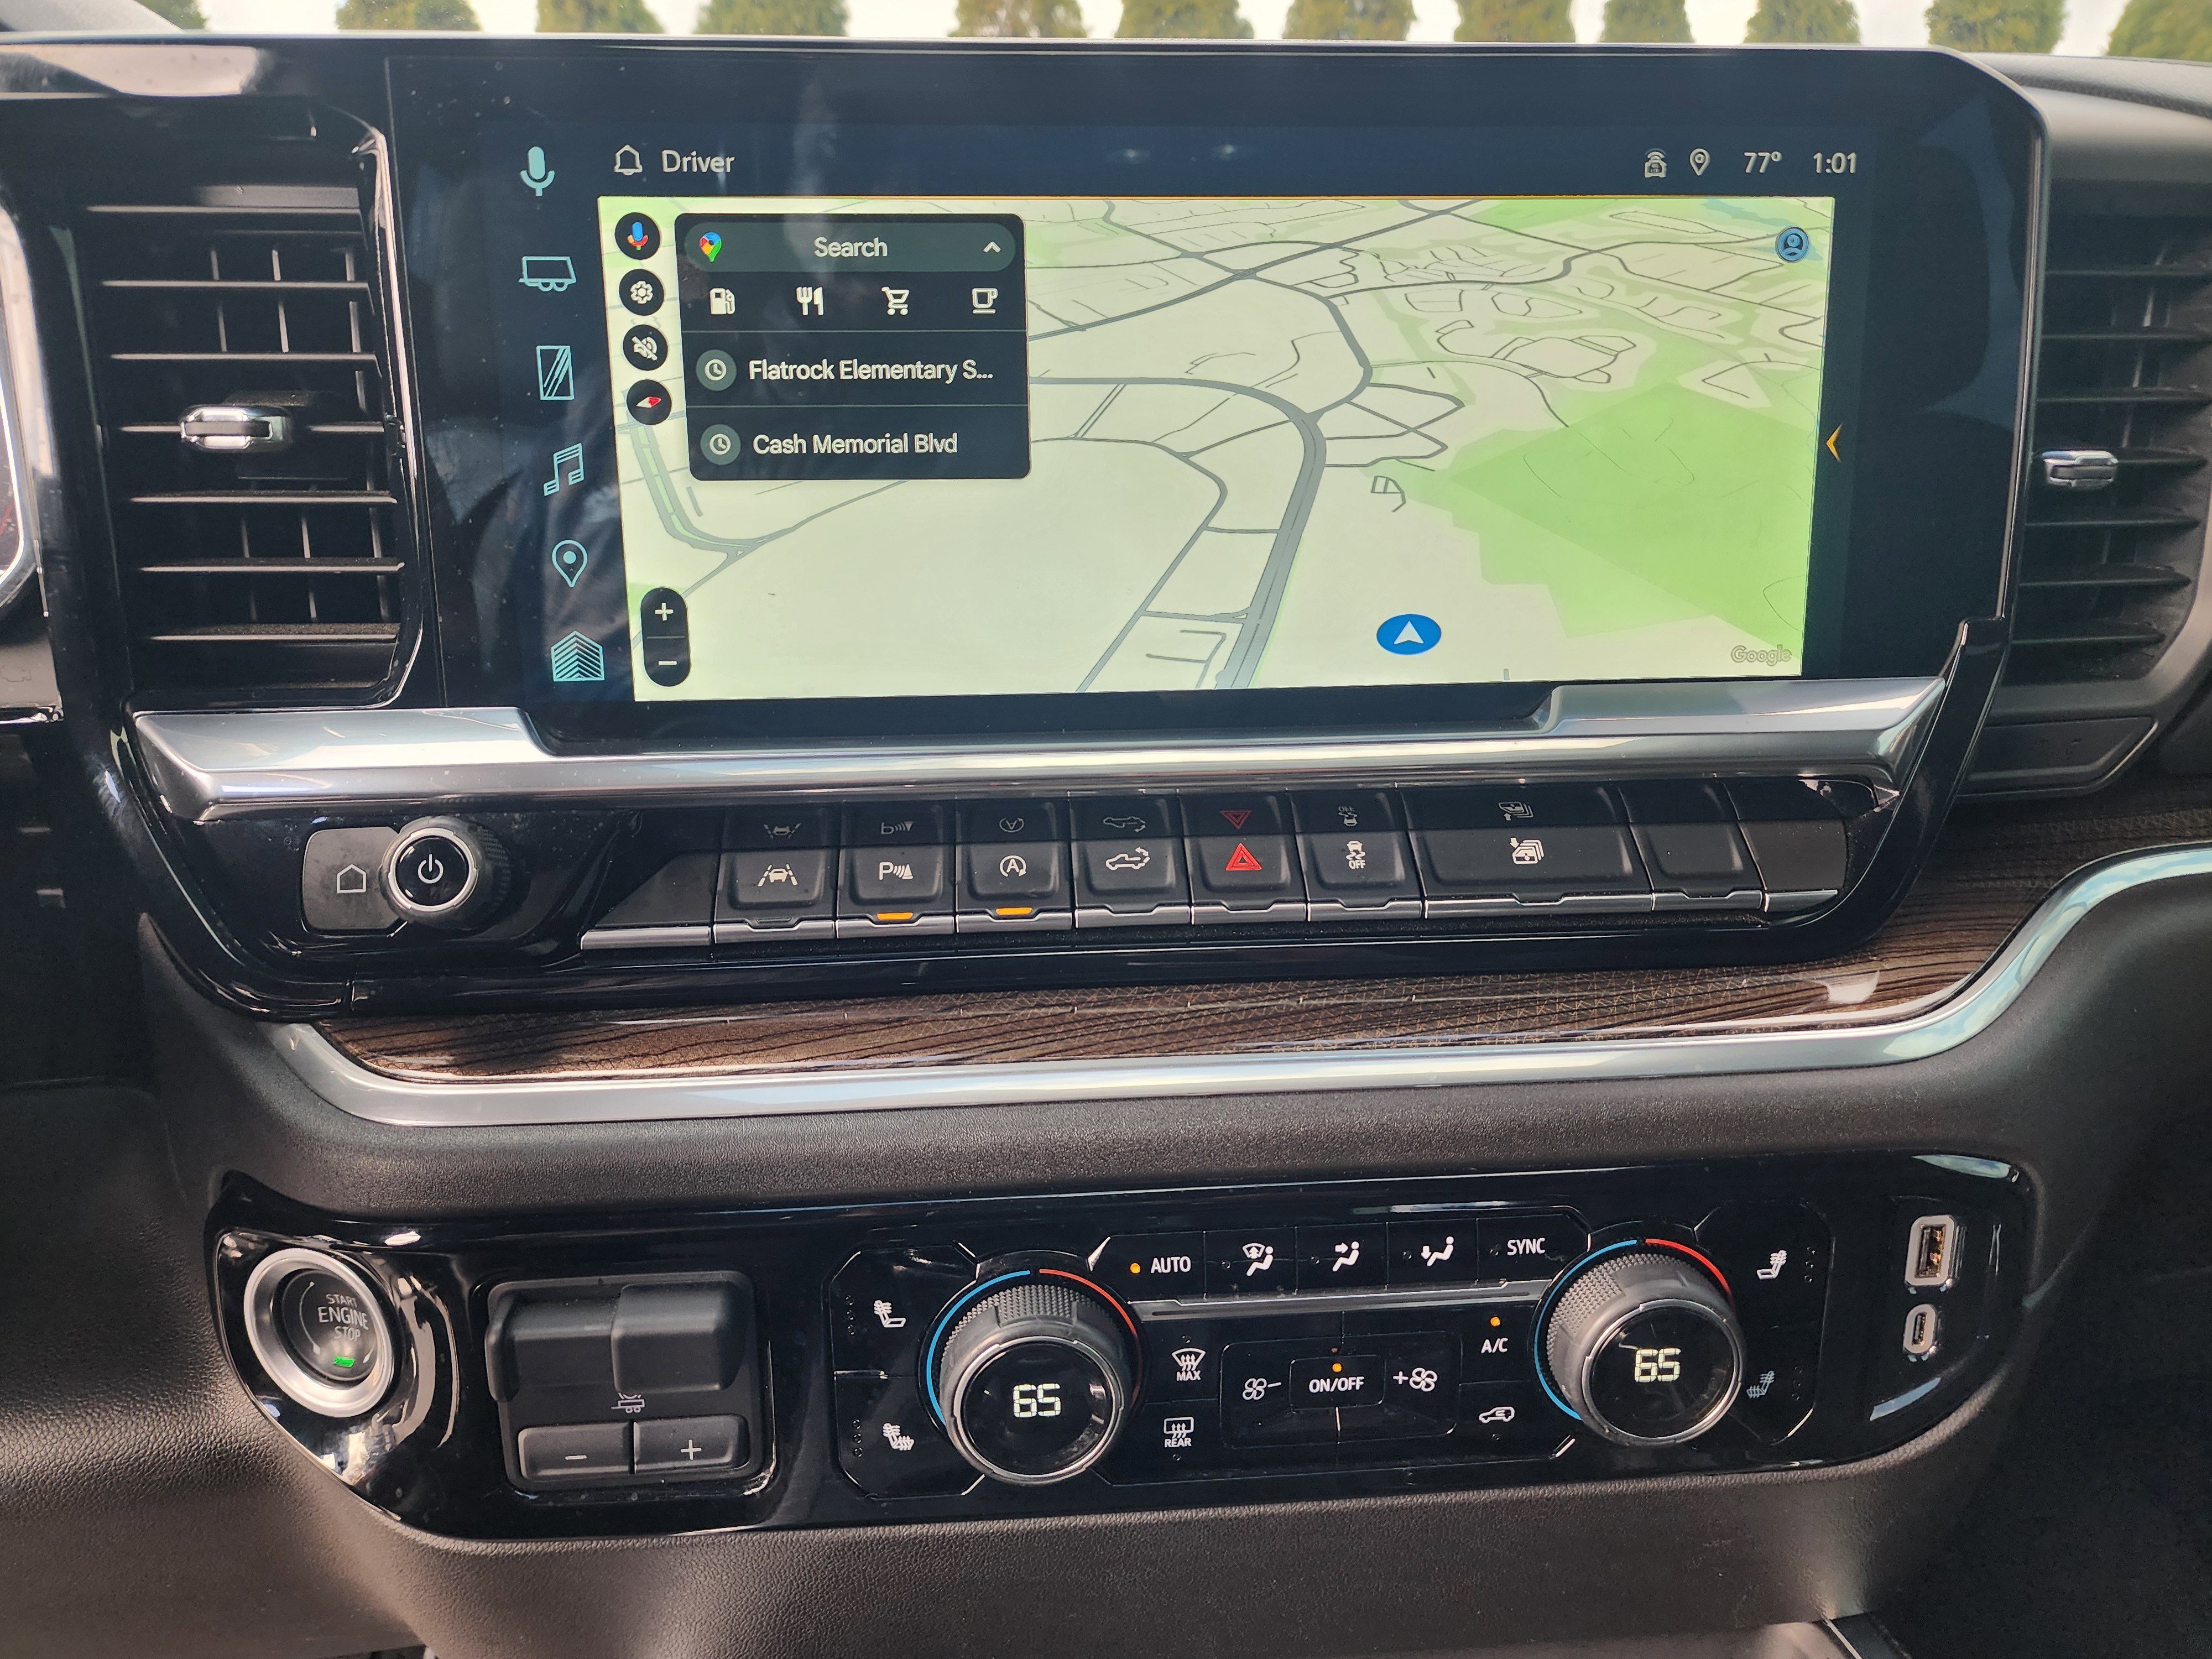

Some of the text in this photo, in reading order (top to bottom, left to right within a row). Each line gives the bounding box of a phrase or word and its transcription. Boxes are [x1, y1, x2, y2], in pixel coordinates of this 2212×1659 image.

[662, 150, 735, 173] Driver
[1744, 151, 1782, 173] 77°
[1813, 152, 1856, 174] 1:01
[814, 236, 888, 258] Search
[749, 360, 993, 384] Flatrock Elementary S...
[753, 432, 958, 454] Cash Memorial Blvd
[1731, 644, 1792, 666] Google
[1348, 859, 1366, 869] OFF
[1507, 1238, 1546, 1256] SYNC
[1151, 1256, 1191, 1274] AUTO
[326, 1293, 357, 1308] START
[317, 1306, 369, 1330] ENGINE
[334, 1326, 361, 1341] STOP
[1481, 1337, 1508, 1354] A/C
[1176, 1370, 1201, 1381] MAX
[1635, 1348, 1681, 1383] 65
[1309, 1375, 1364, 1394] ON/OFF
[1013, 1383, 1061, 1417] 65
[1164, 1437, 1192, 1447] REAR
